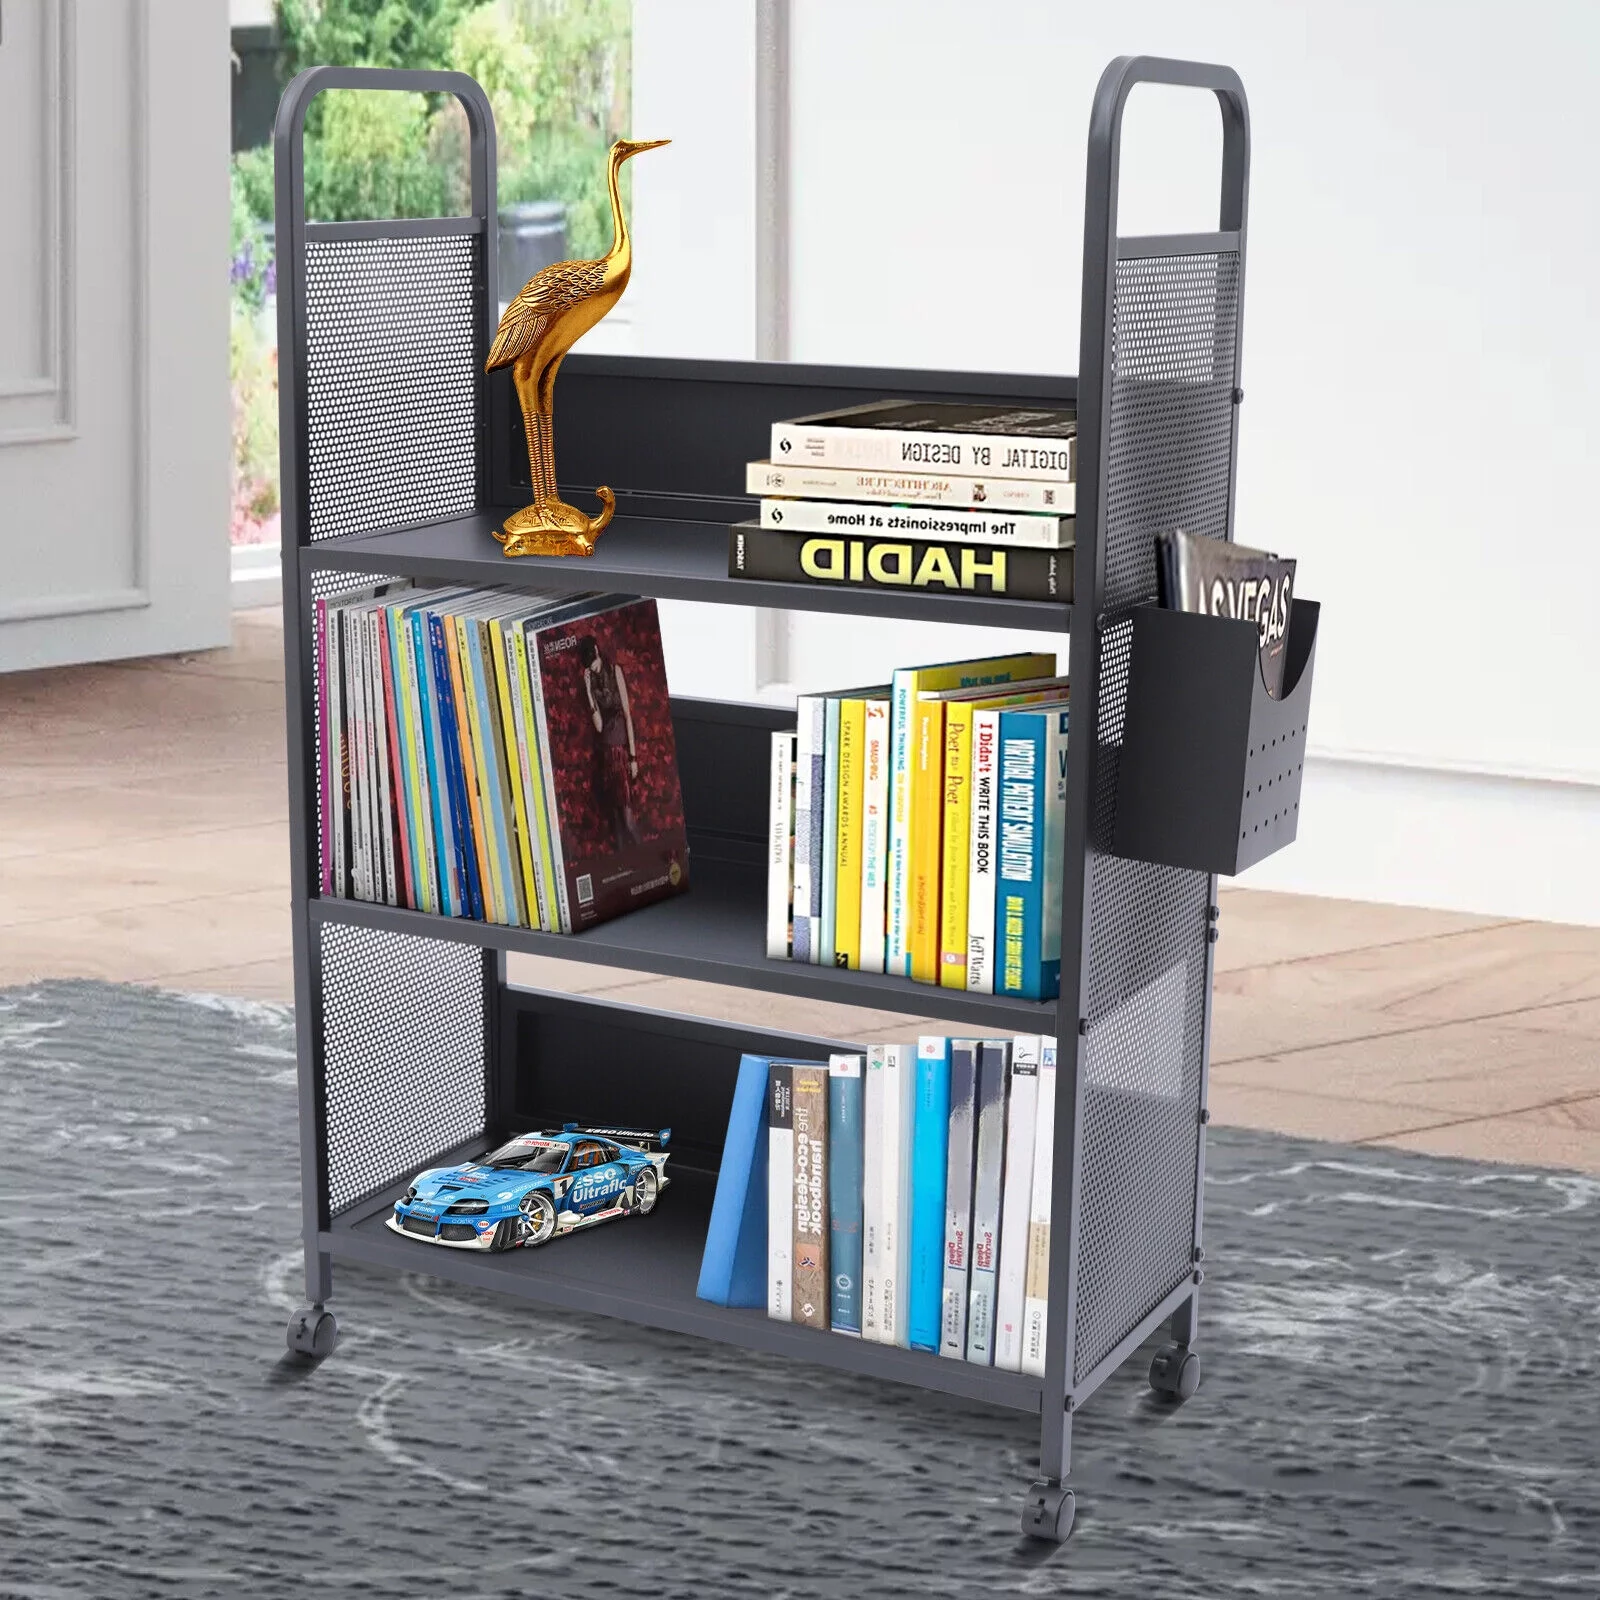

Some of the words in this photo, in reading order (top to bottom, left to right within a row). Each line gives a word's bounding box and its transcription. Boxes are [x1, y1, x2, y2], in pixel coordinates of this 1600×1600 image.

[898, 689, 906, 729] POWERFUL
[897, 732, 905, 771] THINKING
[948, 723, 965, 752] Poet
[978, 733, 993, 773] Didn't
[842, 752, 850, 786] DESIGN
[1003, 739, 1035, 780] VIRTUAL
[947, 776, 964, 804] Poet
[978, 777, 991, 811] WRITE
[1002, 781, 1035, 823] PATIENT
[841, 791, 849, 828] AWARDS
[977, 814, 990, 839] THIS
[840, 833, 849, 867] ANNUAL
[977, 843, 989, 874] BOOK
[1001, 822, 1033, 881] SIMULATION
[969, 934, 985, 954] Jeff
[970, 955, 985, 985] Watts
[559, 1179, 569, 1195] 1
